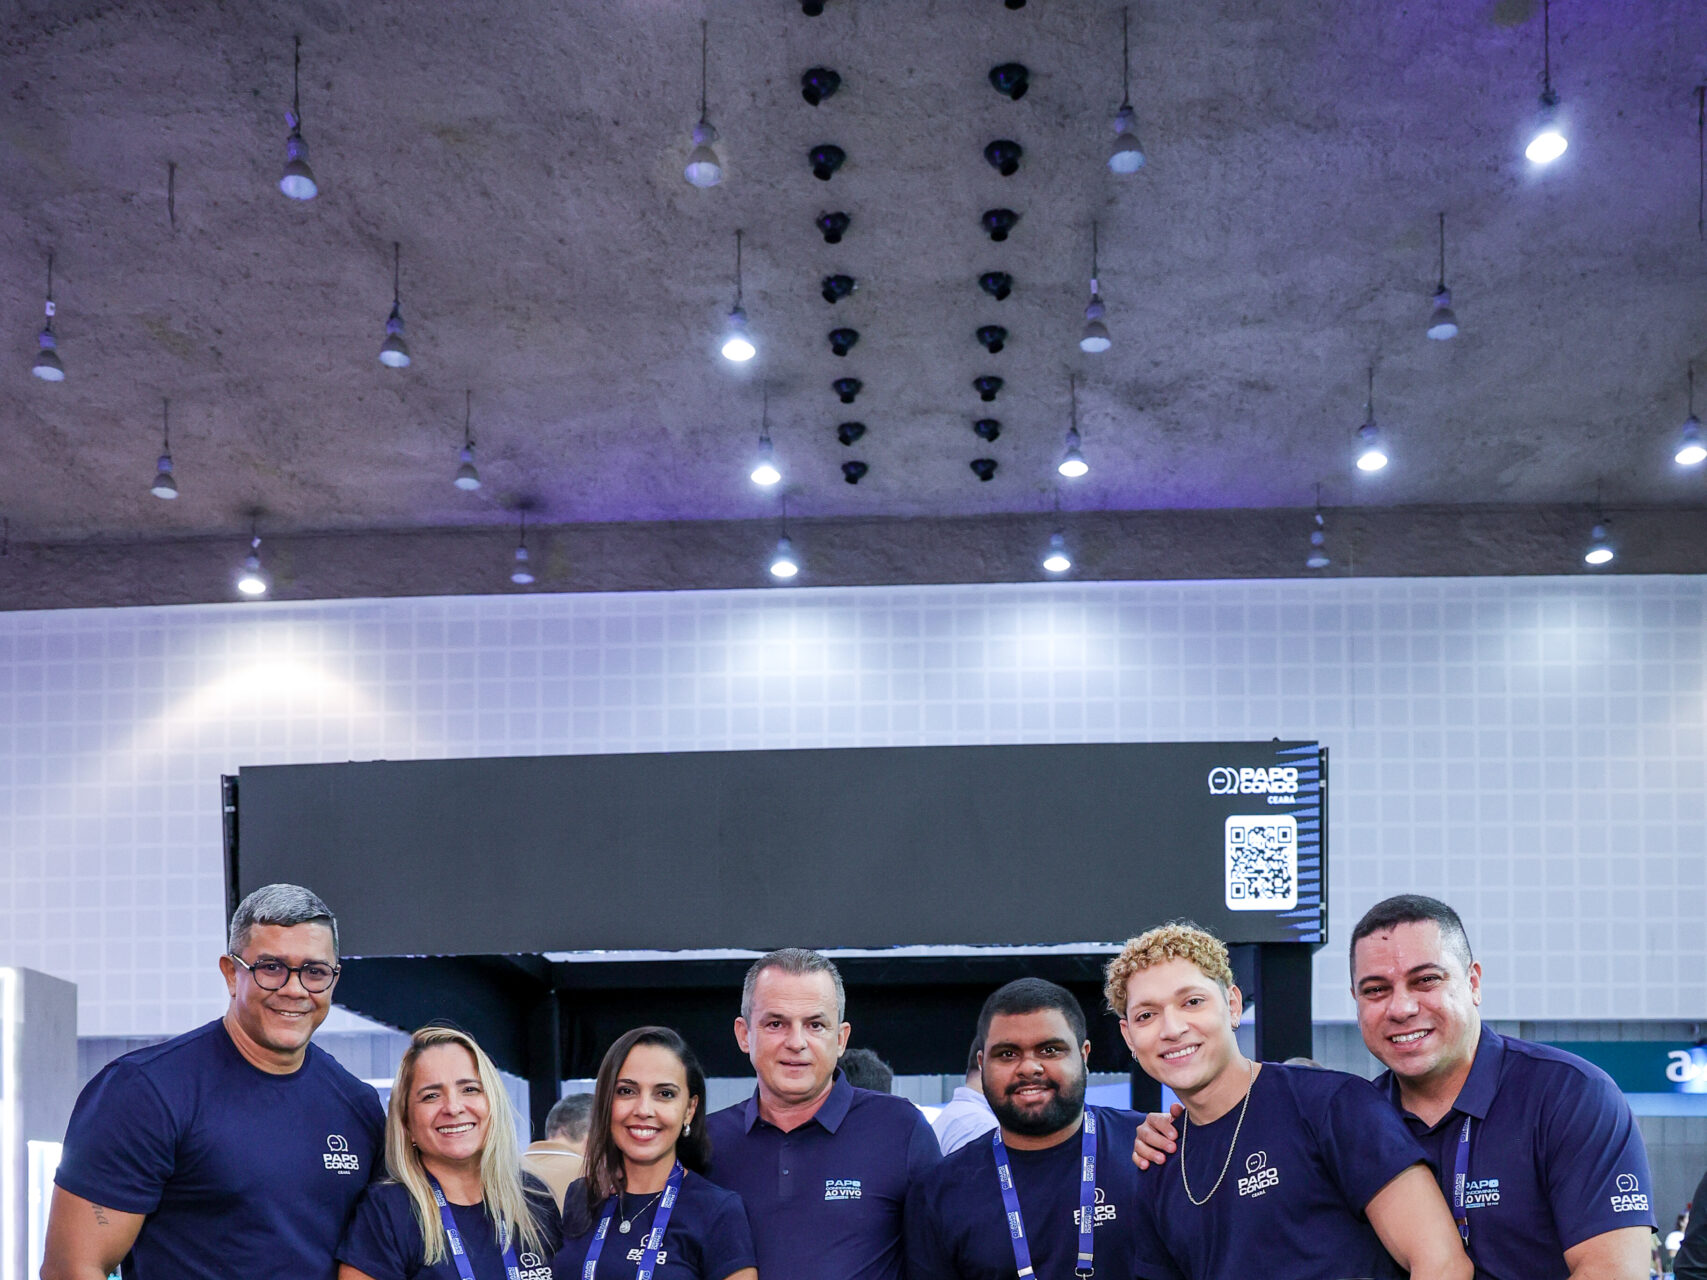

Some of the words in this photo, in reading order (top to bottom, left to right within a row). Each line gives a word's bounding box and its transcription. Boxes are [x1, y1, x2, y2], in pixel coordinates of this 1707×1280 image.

[1240, 768, 1298, 782] PAPO
[1240, 781, 1298, 794] CONDO
[1267, 794, 1296, 804] CEARÁ
[323, 1154, 358, 1163] PAPO
[325, 1162, 359, 1170] CONDO
[1238, 1168, 1278, 1189] PAPO
[1239, 1177, 1279, 1196] CONDO
[1465, 1195, 1473, 1204] O
[1474, 1193, 1500, 1203] VIVO
[1610, 1194, 1647, 1205] PAPO
[1074, 1205, 1116, 1220] PPO
[1613, 1203, 1649, 1212] CONDO
[1075, 1213, 1116, 1225] CNDO
[626, 1254, 666, 1265] COO
[628, 1248, 667, 1260] PAO
[520, 1267, 552, 1279] PAPO
